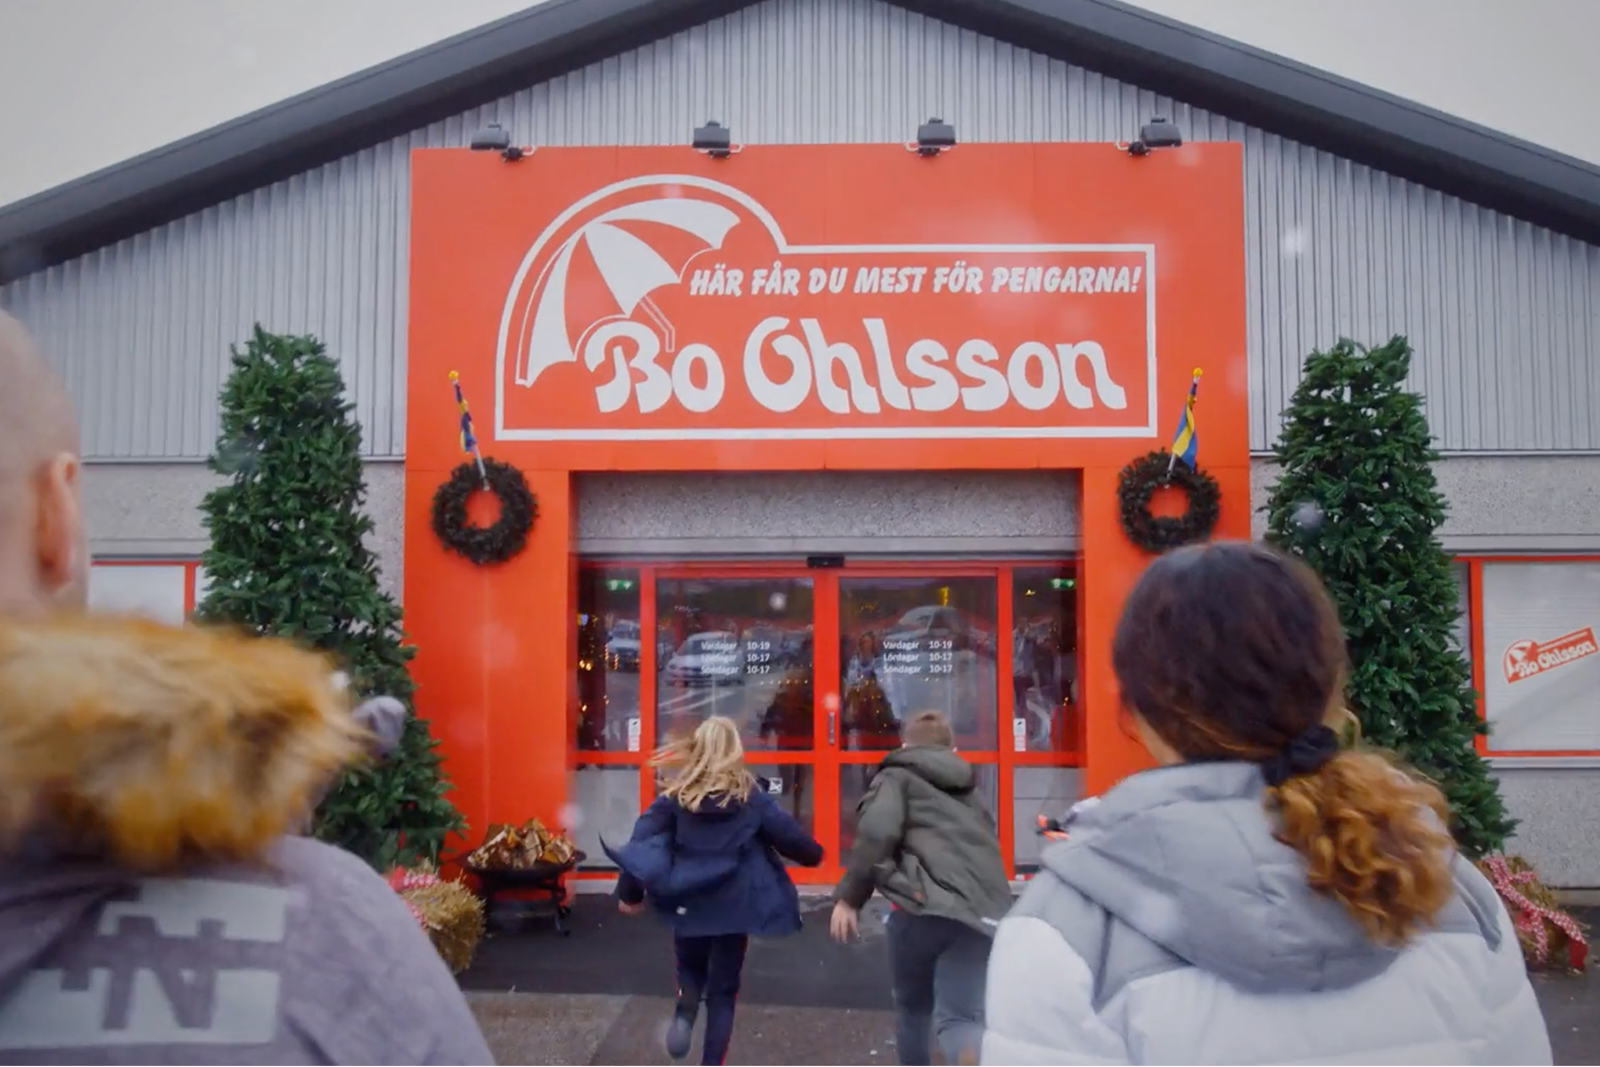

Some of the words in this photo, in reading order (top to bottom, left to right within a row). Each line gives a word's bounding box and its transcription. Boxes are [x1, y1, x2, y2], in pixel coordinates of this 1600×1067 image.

[690, 264, 743, 297] HÄR
[751, 260, 800, 297] FÅR
[808, 267, 848, 295] DU
[854, 266, 928, 294] MEST
[934, 261, 985, 295] FÖR
[991, 265, 1142, 294] PENGARNA!
[584, 320, 725, 414] Bo
[743, 317, 1128, 414] Ohlsson
[746, 641, 771, 650] 10-19
[882, 640, 920, 651] Vardagar
[928, 640, 953, 649] 10-19
[746, 653, 771, 662] 10-17
[928, 652, 953, 662] 10-17
[746, 665, 771, 674] 10-17
[928, 664, 953, 673] 10-17
